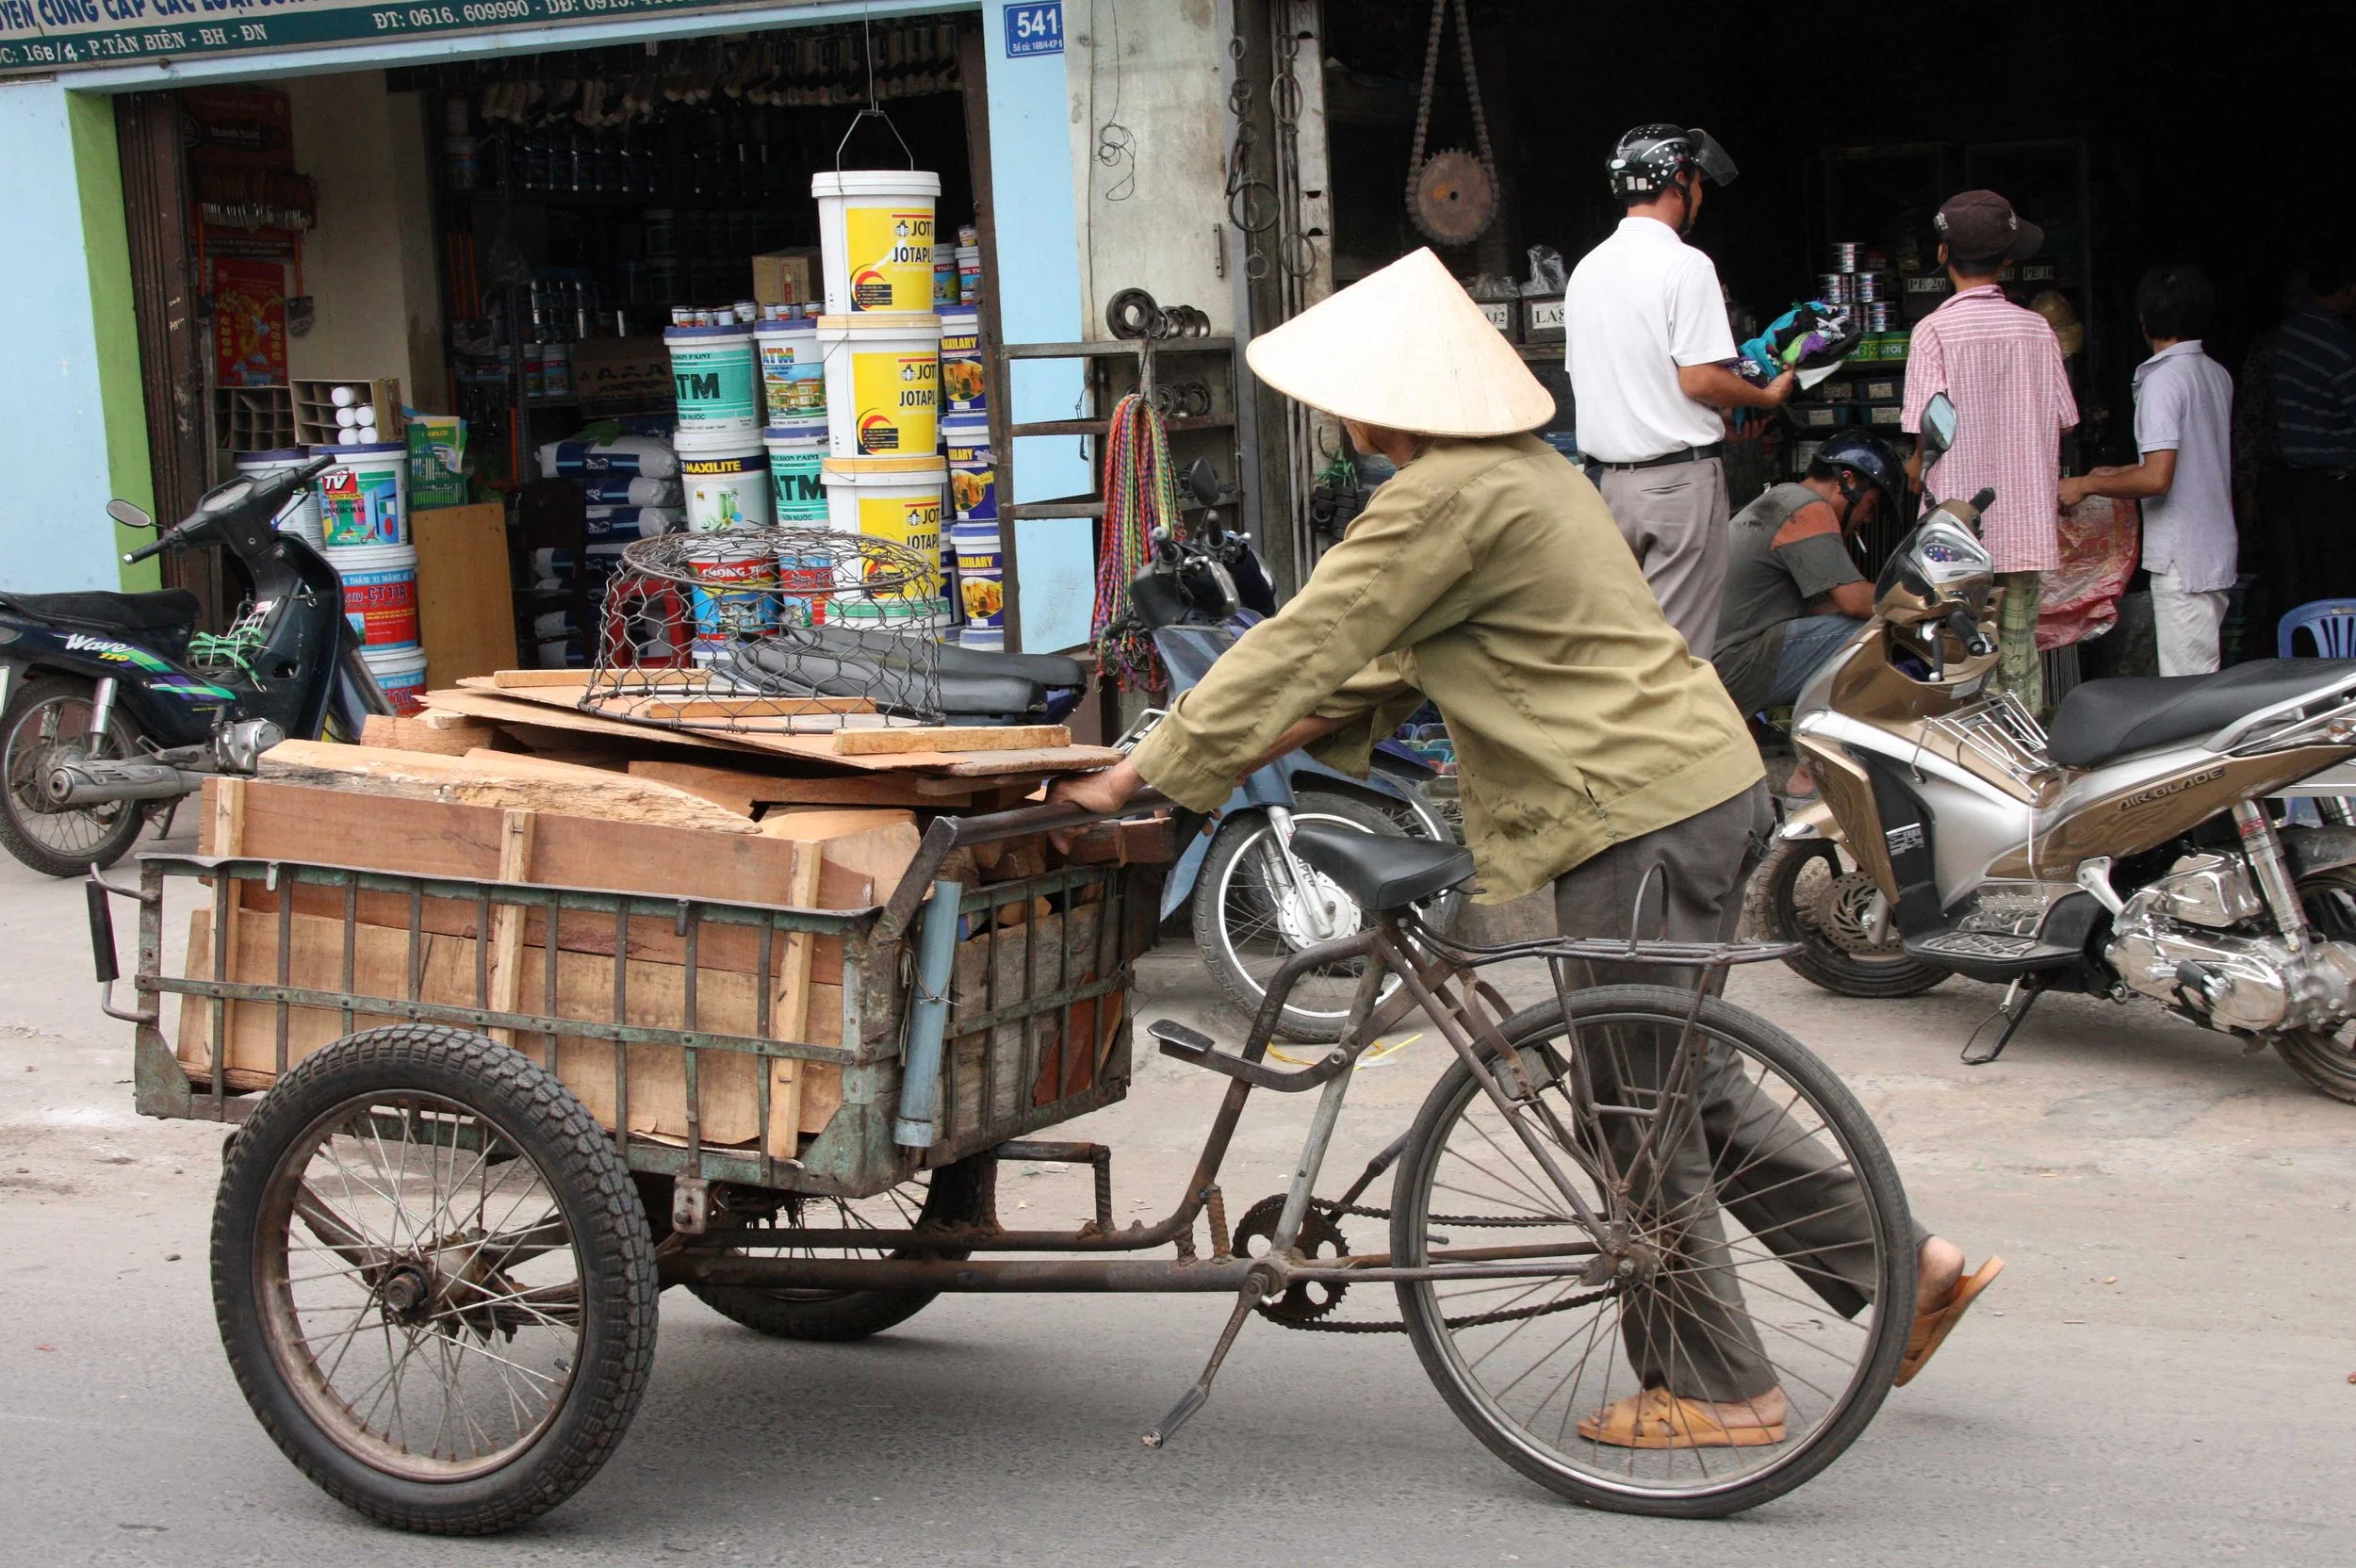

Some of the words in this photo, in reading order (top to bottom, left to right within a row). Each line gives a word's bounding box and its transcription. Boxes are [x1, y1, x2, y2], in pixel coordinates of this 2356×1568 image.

[38, 0, 100, 26] CUNG
[372, 11, 406, 29] ĐT:
[409, 7, 460, 26] 0616.
[462, 1, 531, 22] 609990
[1018, 8, 1057, 38] 541
[0, 47, 20, 64] C:
[88, 33, 140, 57] P.TÂN
[143, 29, 187, 51] BIÊN
[199, 28, 228, 46] BH
[242, 24, 269, 42] ĐN
[1908, 279, 1926, 289] PE
[1931, 278, 1945, 289] 20
[761, 347, 794, 364] ATM
[686, 461, 742, 473] MAXILITE
[324, 475, 352, 490] TV
[773, 473, 827, 501] ATM
[65, 633, 135, 653] Wave
[2119, 792, 2151, 810] AIR
[2153, 766, 2227, 799] BLADE
